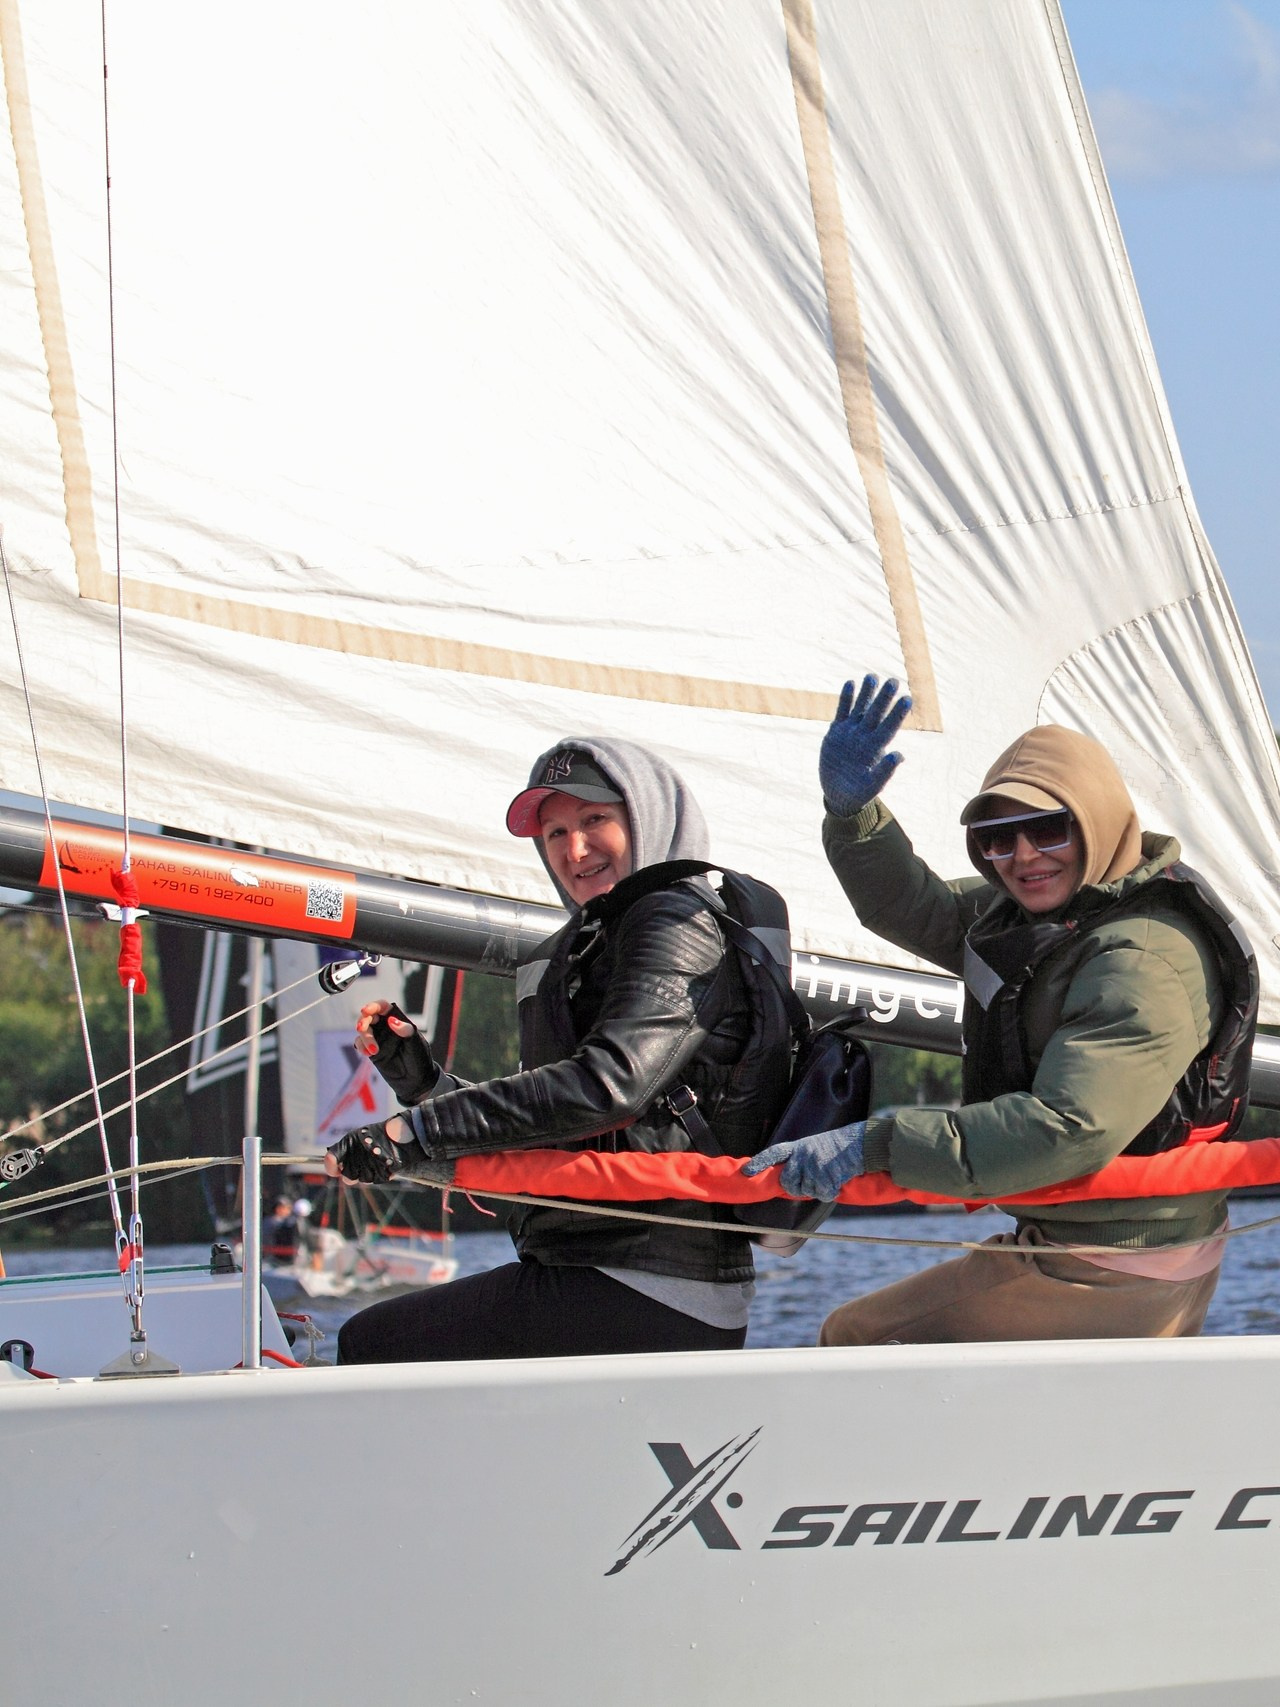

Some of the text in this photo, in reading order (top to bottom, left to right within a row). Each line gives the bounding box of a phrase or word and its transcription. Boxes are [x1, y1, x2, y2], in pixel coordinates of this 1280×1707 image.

[182, 866, 236, 886] SAILIN
[152, 879, 274, 907] +7916 1927400
[760, 1490, 1195, 1550] SAILING
